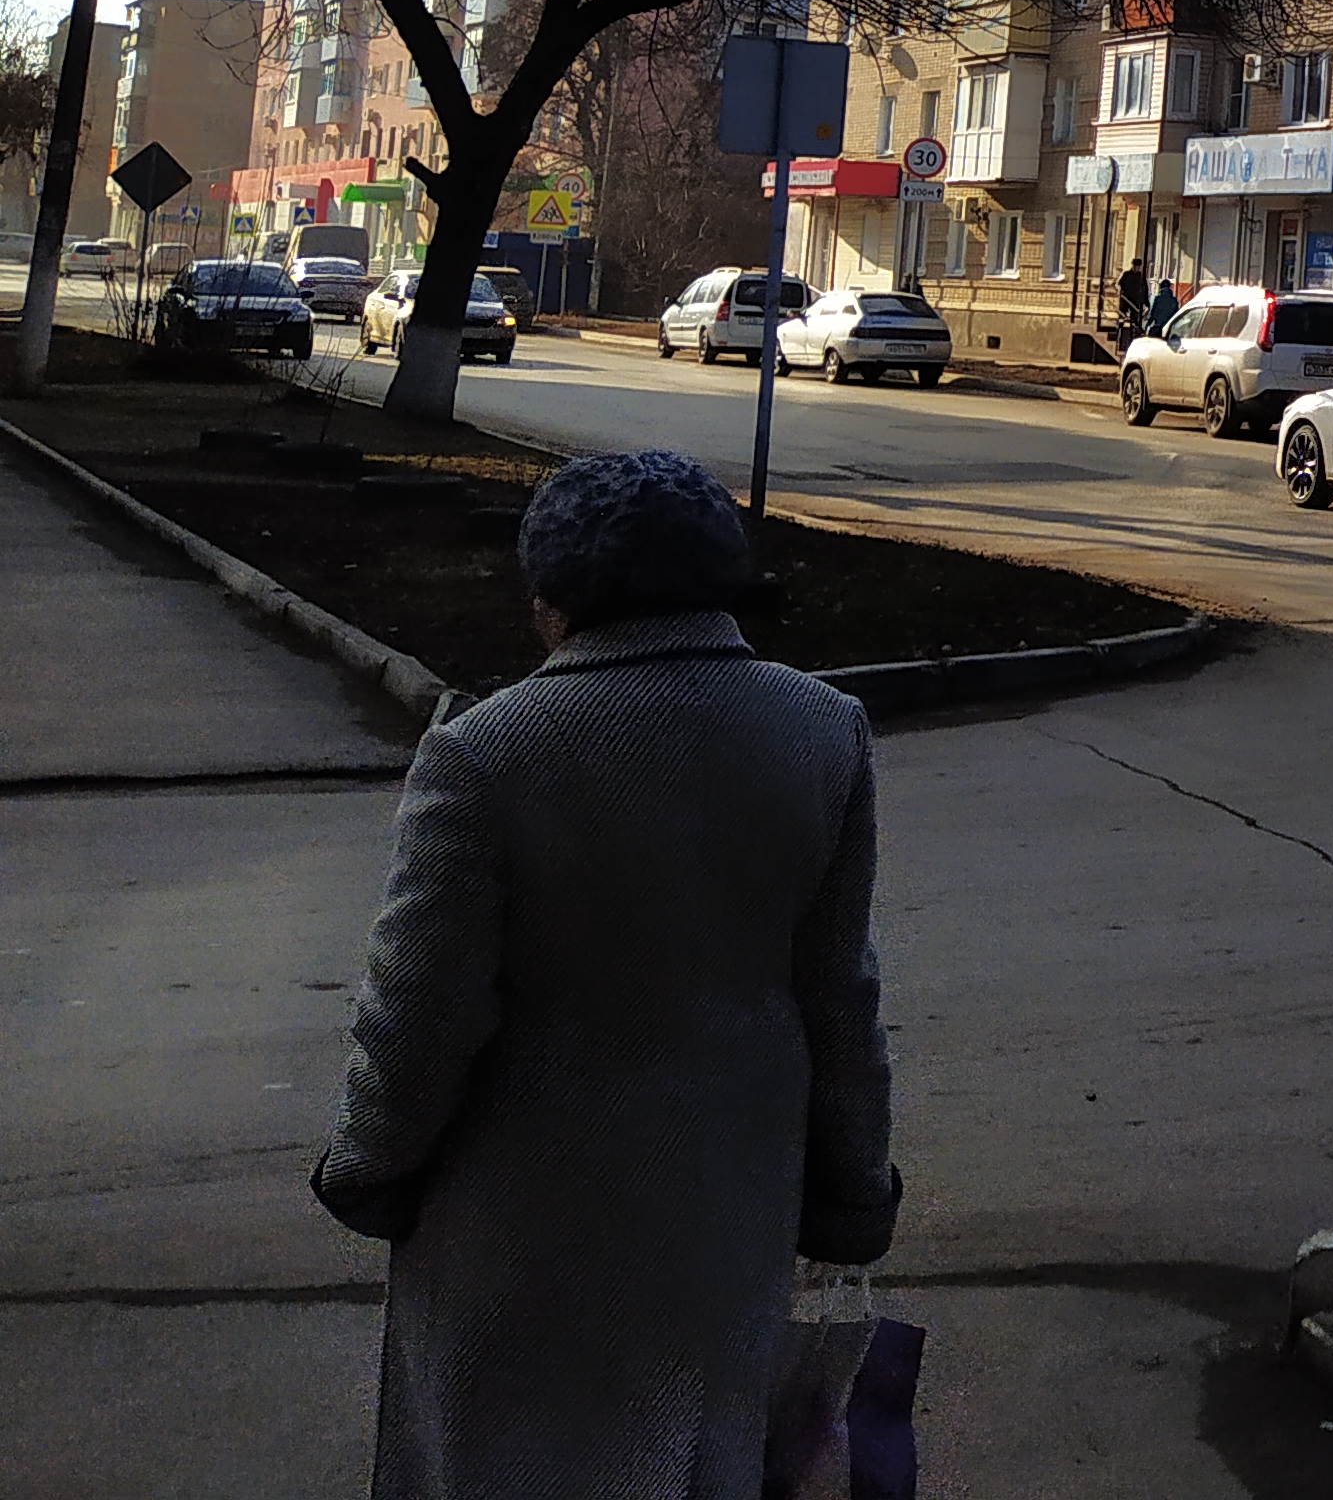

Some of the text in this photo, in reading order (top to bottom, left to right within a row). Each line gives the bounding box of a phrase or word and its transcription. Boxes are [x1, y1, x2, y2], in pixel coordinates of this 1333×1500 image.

[913, 149, 938, 167] 30
[1188, 150, 1237, 183] НАША
[561, 181, 580, 193] 40
